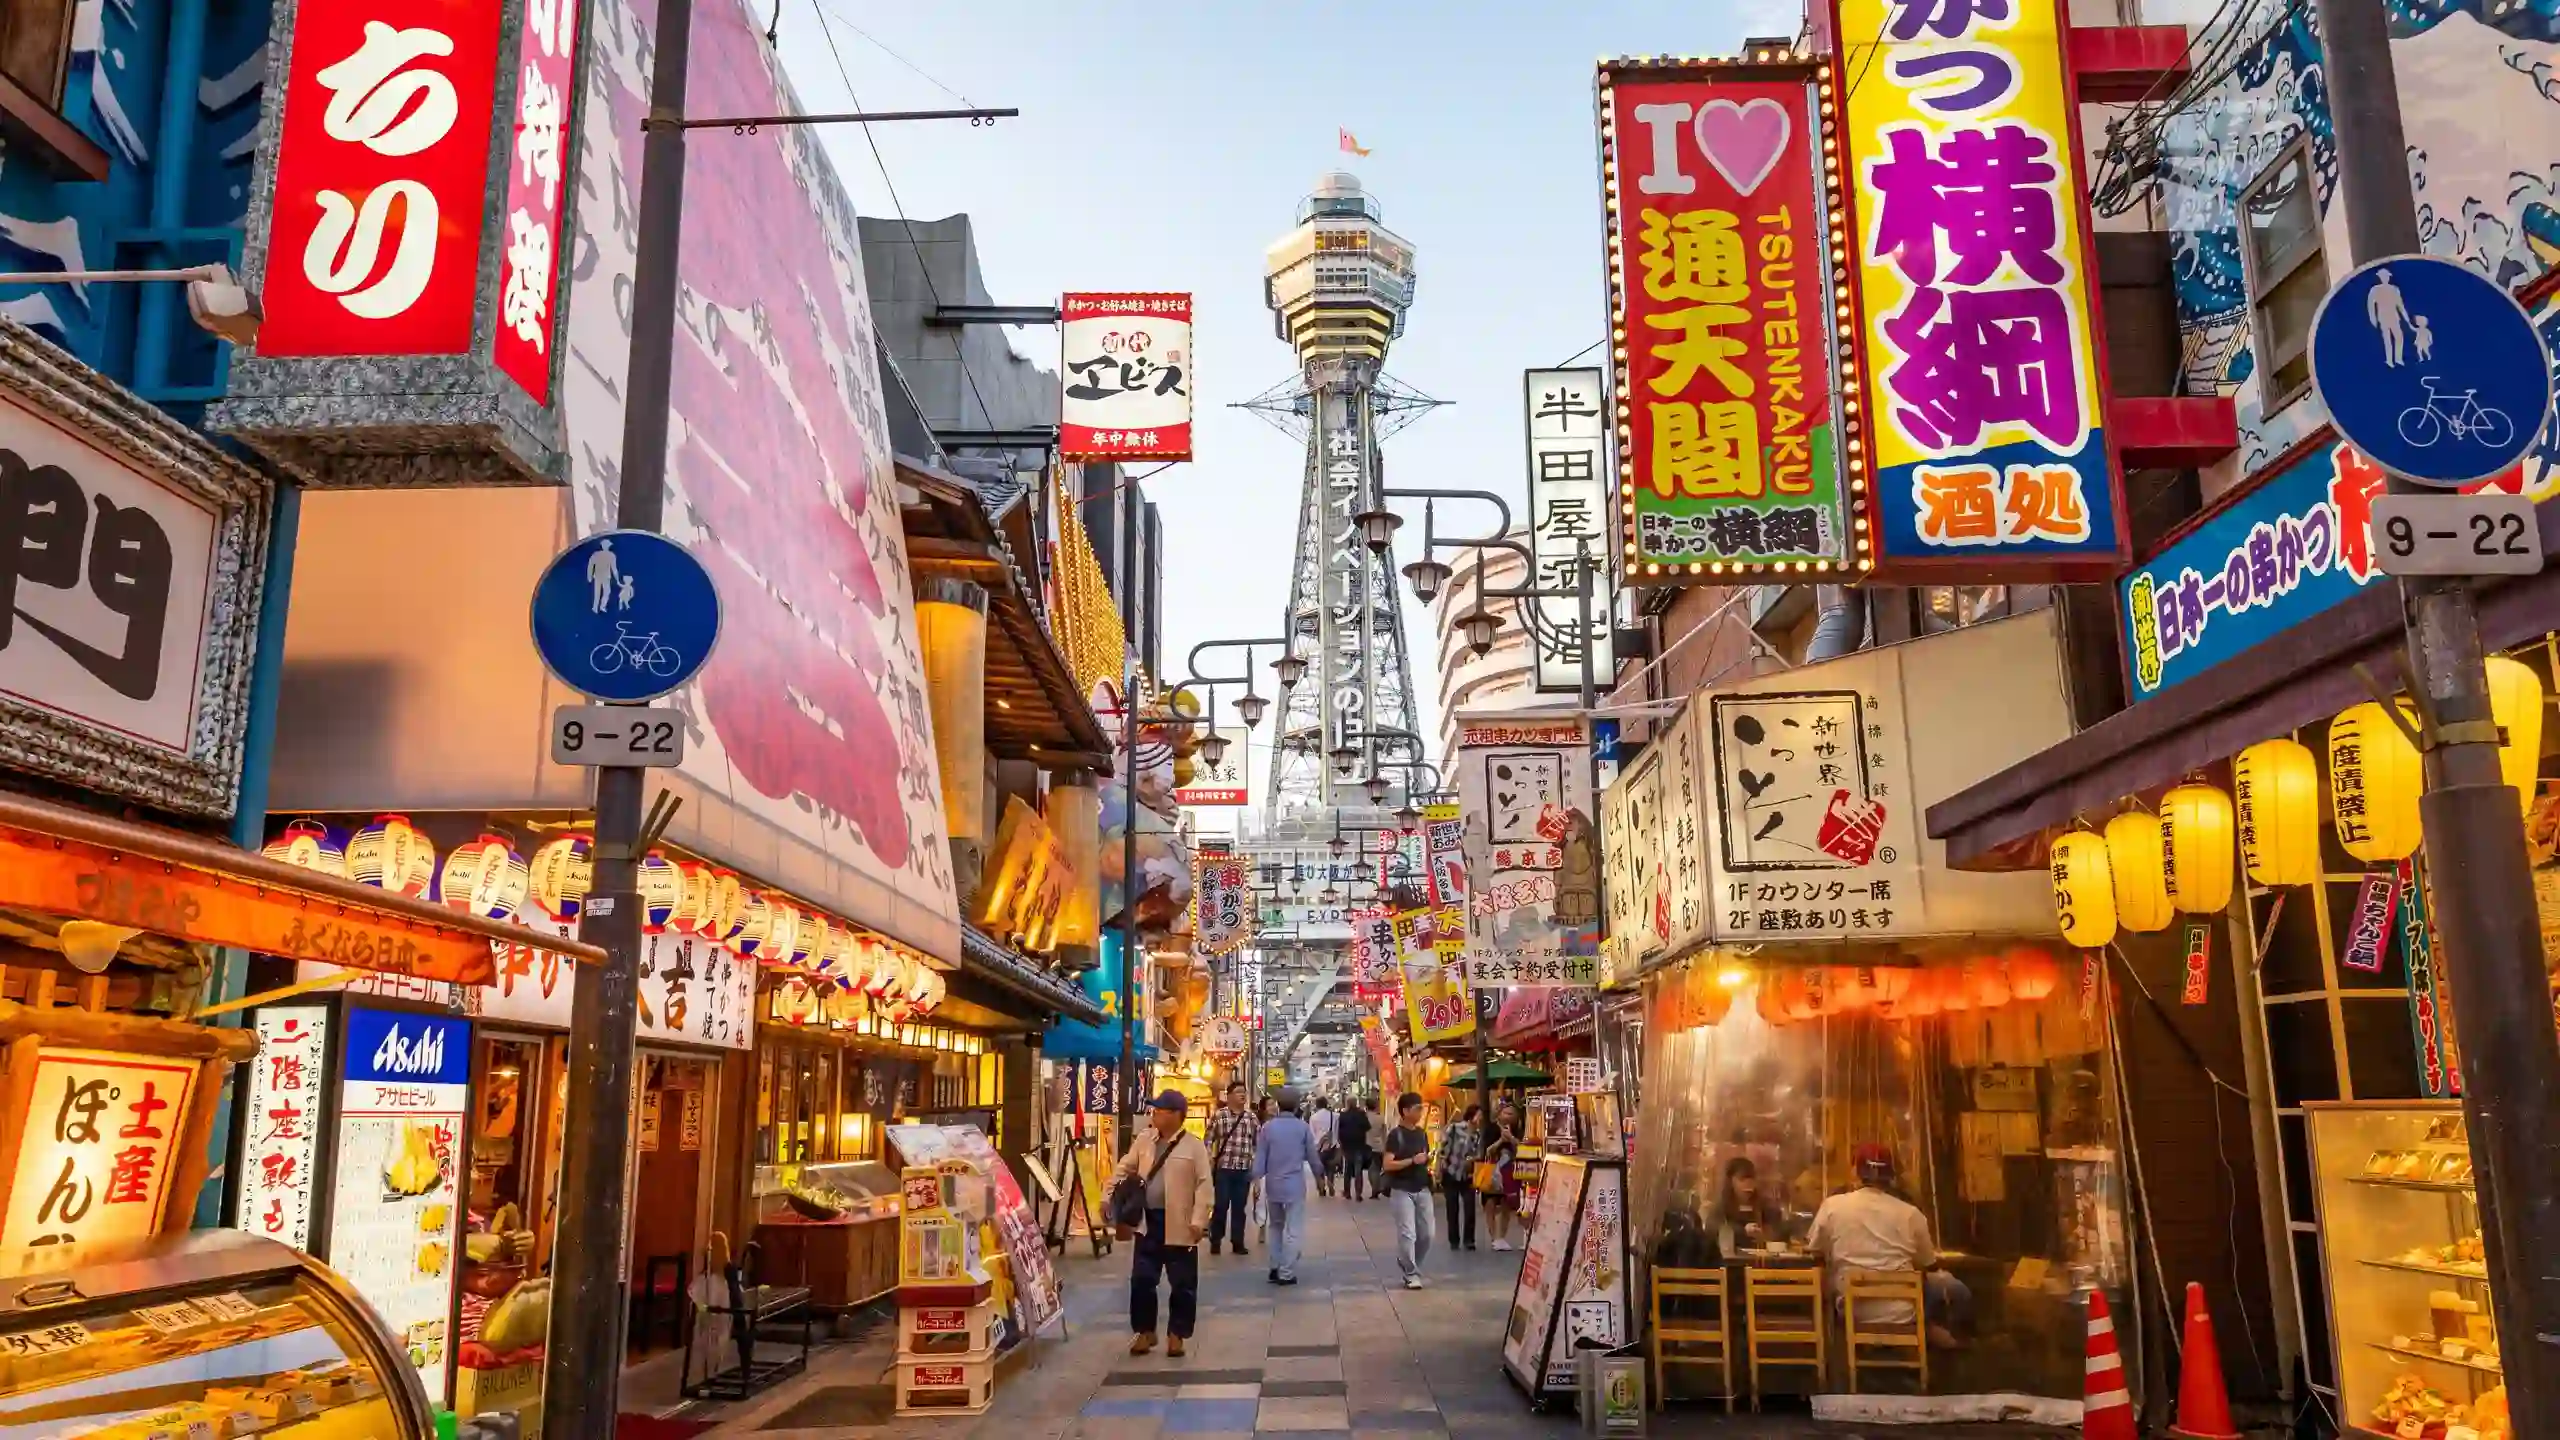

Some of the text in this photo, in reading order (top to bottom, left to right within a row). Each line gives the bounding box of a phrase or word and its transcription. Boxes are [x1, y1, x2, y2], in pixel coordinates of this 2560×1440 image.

[1634, 102, 1696, 194] I
[1870, 126, 2083, 451] 横綱
[1641, 208, 1763, 498] 通天閣
[1756, 204, 1813, 493] TSUTENKAKU
[1091, 431, 1160, 448] 年中無休
[1642, 515, 1706, 531] 日本一の
[1920, 470, 2084, 539] 酒処
[1643, 534, 1707, 554] 串かつ
[1706, 506, 1820, 555] 横綱
[2156, 508, 2332, 655] 日本一の串かつ
[1756, 879, 1892, 902] カウンター席
[1758, 907, 1894, 931] 座敷あります
[1473, 960, 1594, 980] 宴会予約受付中
[372, 1021, 445, 1075] Asahi
[374, 1087, 436, 1107] アサヒビール
[103, 1081, 167, 1205] 土産
